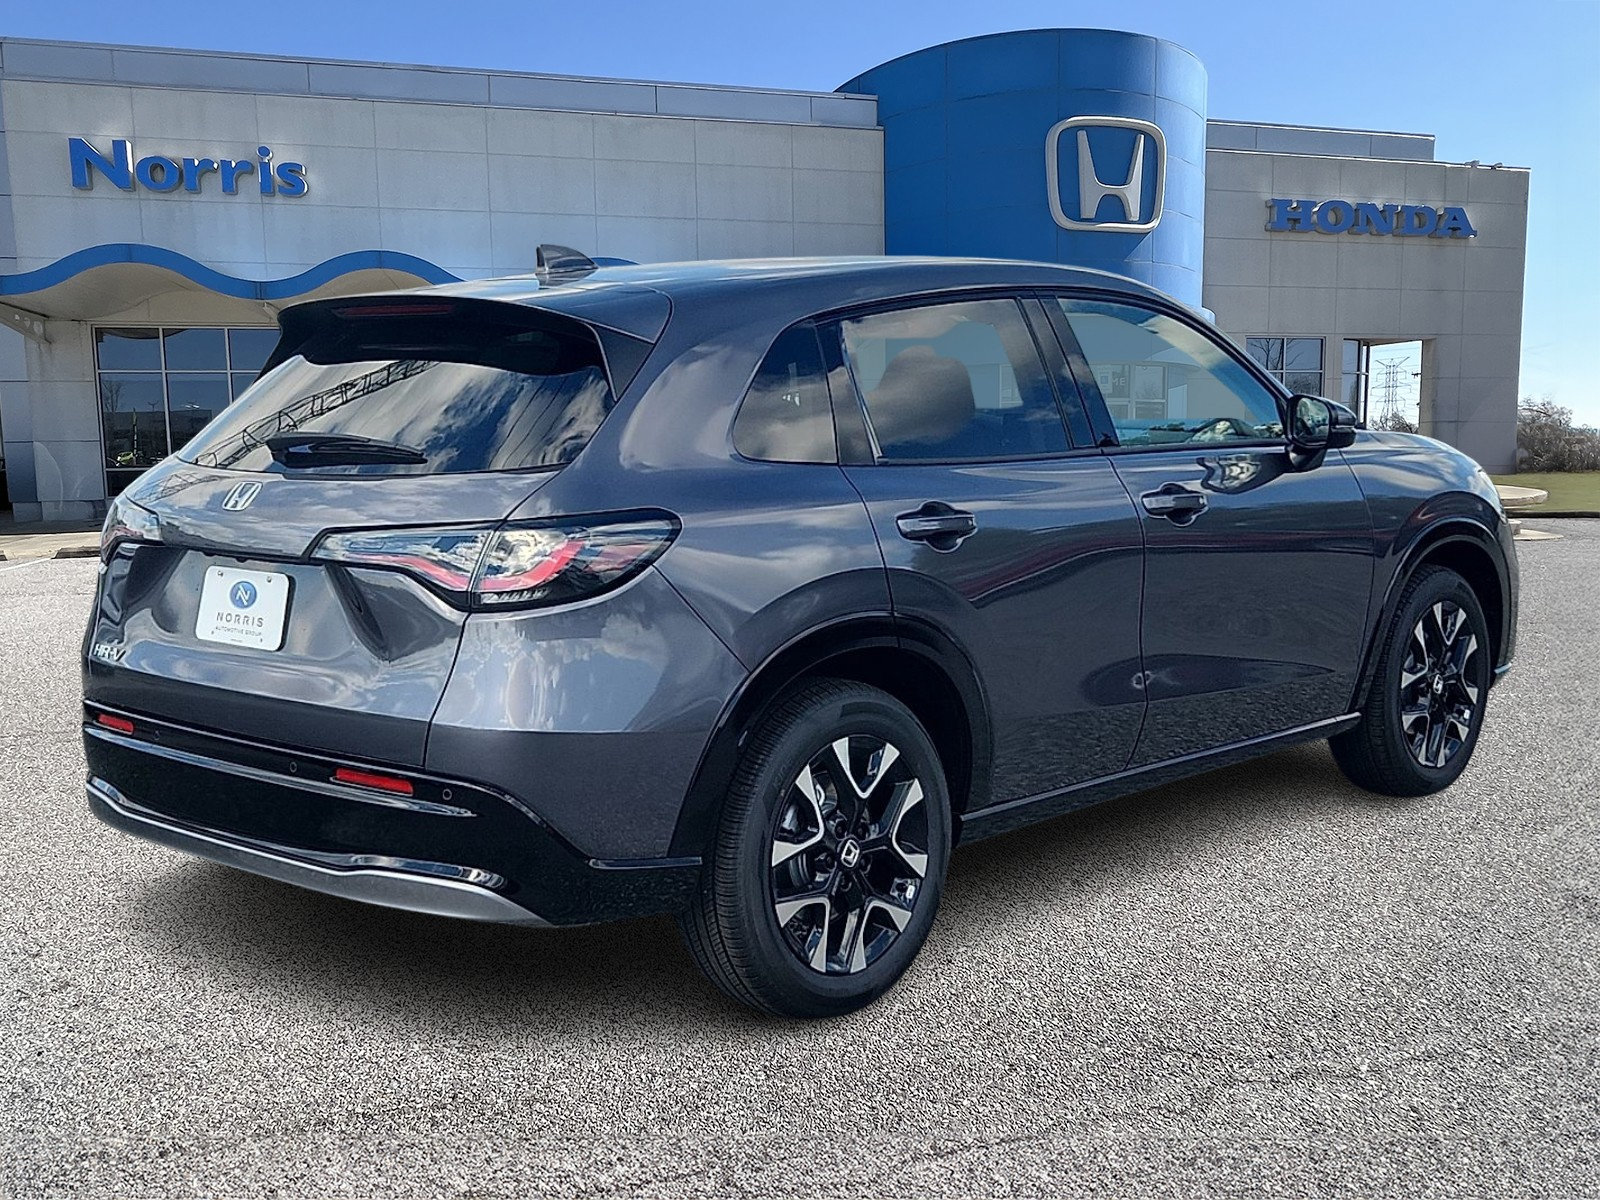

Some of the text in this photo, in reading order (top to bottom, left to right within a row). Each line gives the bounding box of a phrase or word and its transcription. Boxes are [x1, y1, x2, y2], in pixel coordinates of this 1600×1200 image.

[68, 137, 309, 197] Norris
[1266, 198, 1478, 239] HONDA
[216, 612, 264, 628] NORRIS
[93, 643, 126, 661] HR-V
